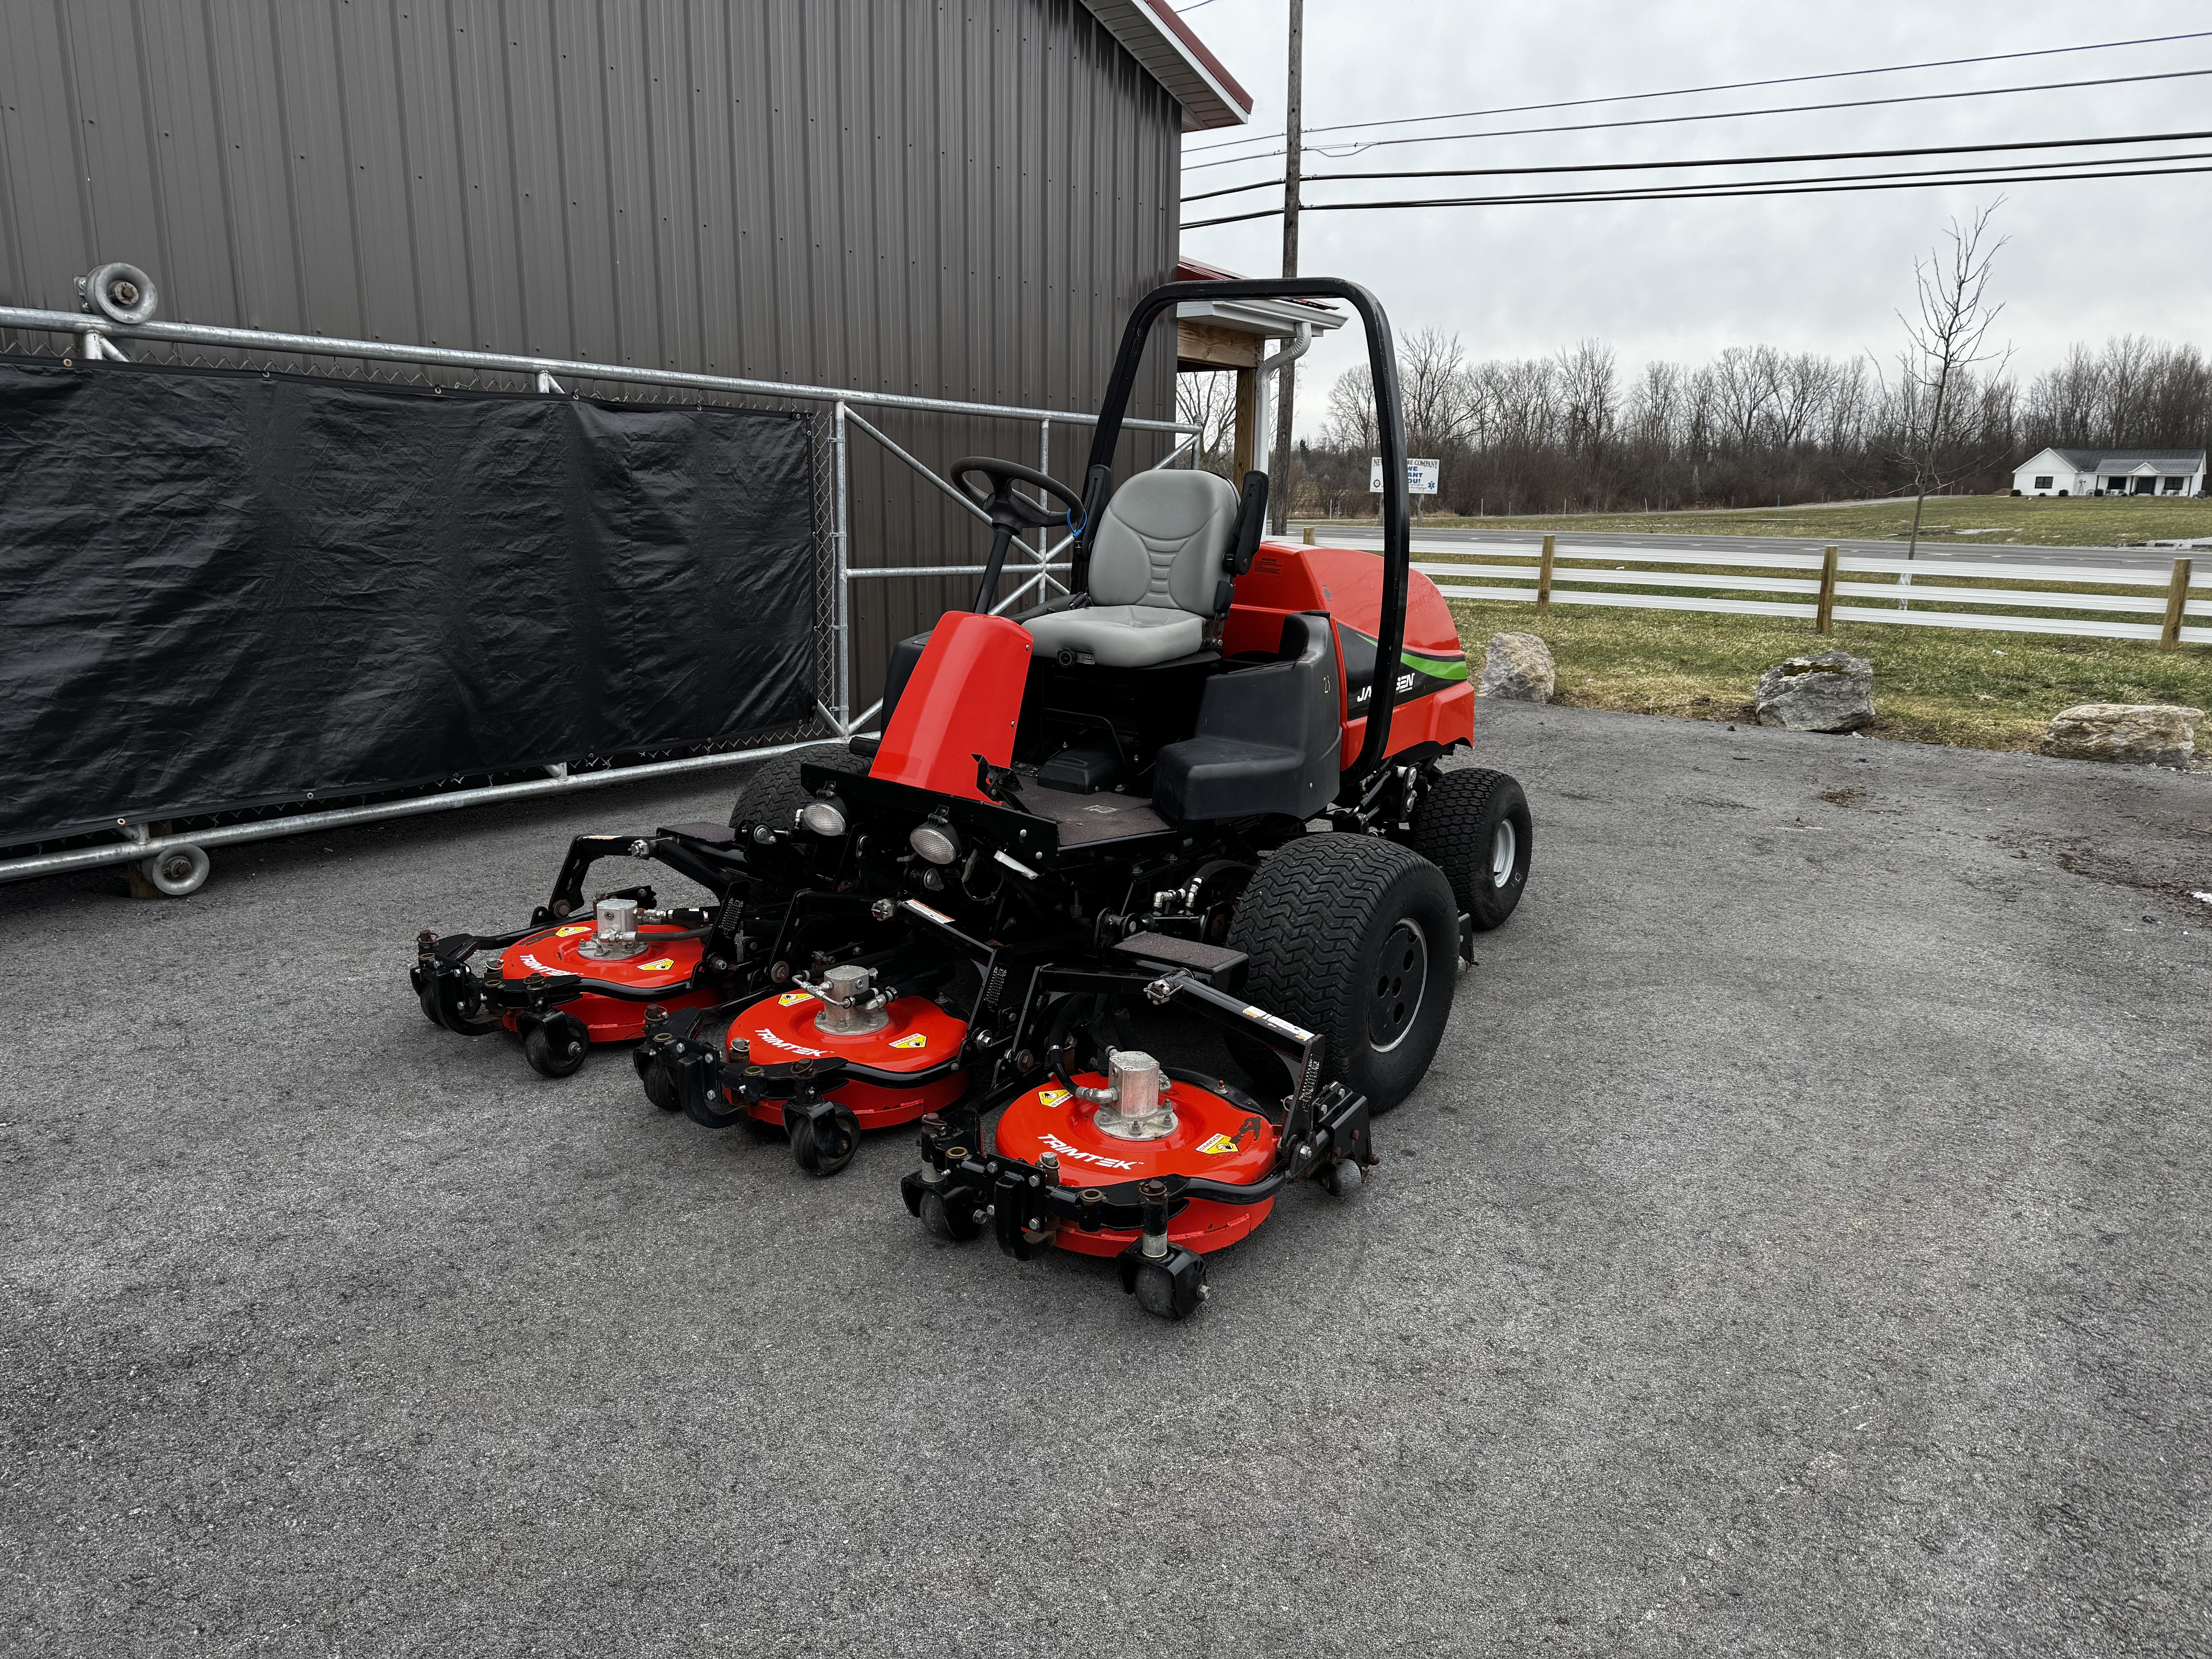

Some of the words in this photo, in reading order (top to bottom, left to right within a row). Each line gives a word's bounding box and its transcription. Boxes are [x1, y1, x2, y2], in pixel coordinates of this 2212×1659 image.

[1414, 460, 1438, 469] COMPANY
[754, 1028, 829, 1057] TRIMTEK
[891, 1034, 919, 1046] DANGER
[1199, 1135, 1222, 1151] DANGER
[1037, 1133, 1138, 1170] TRIMTEK
